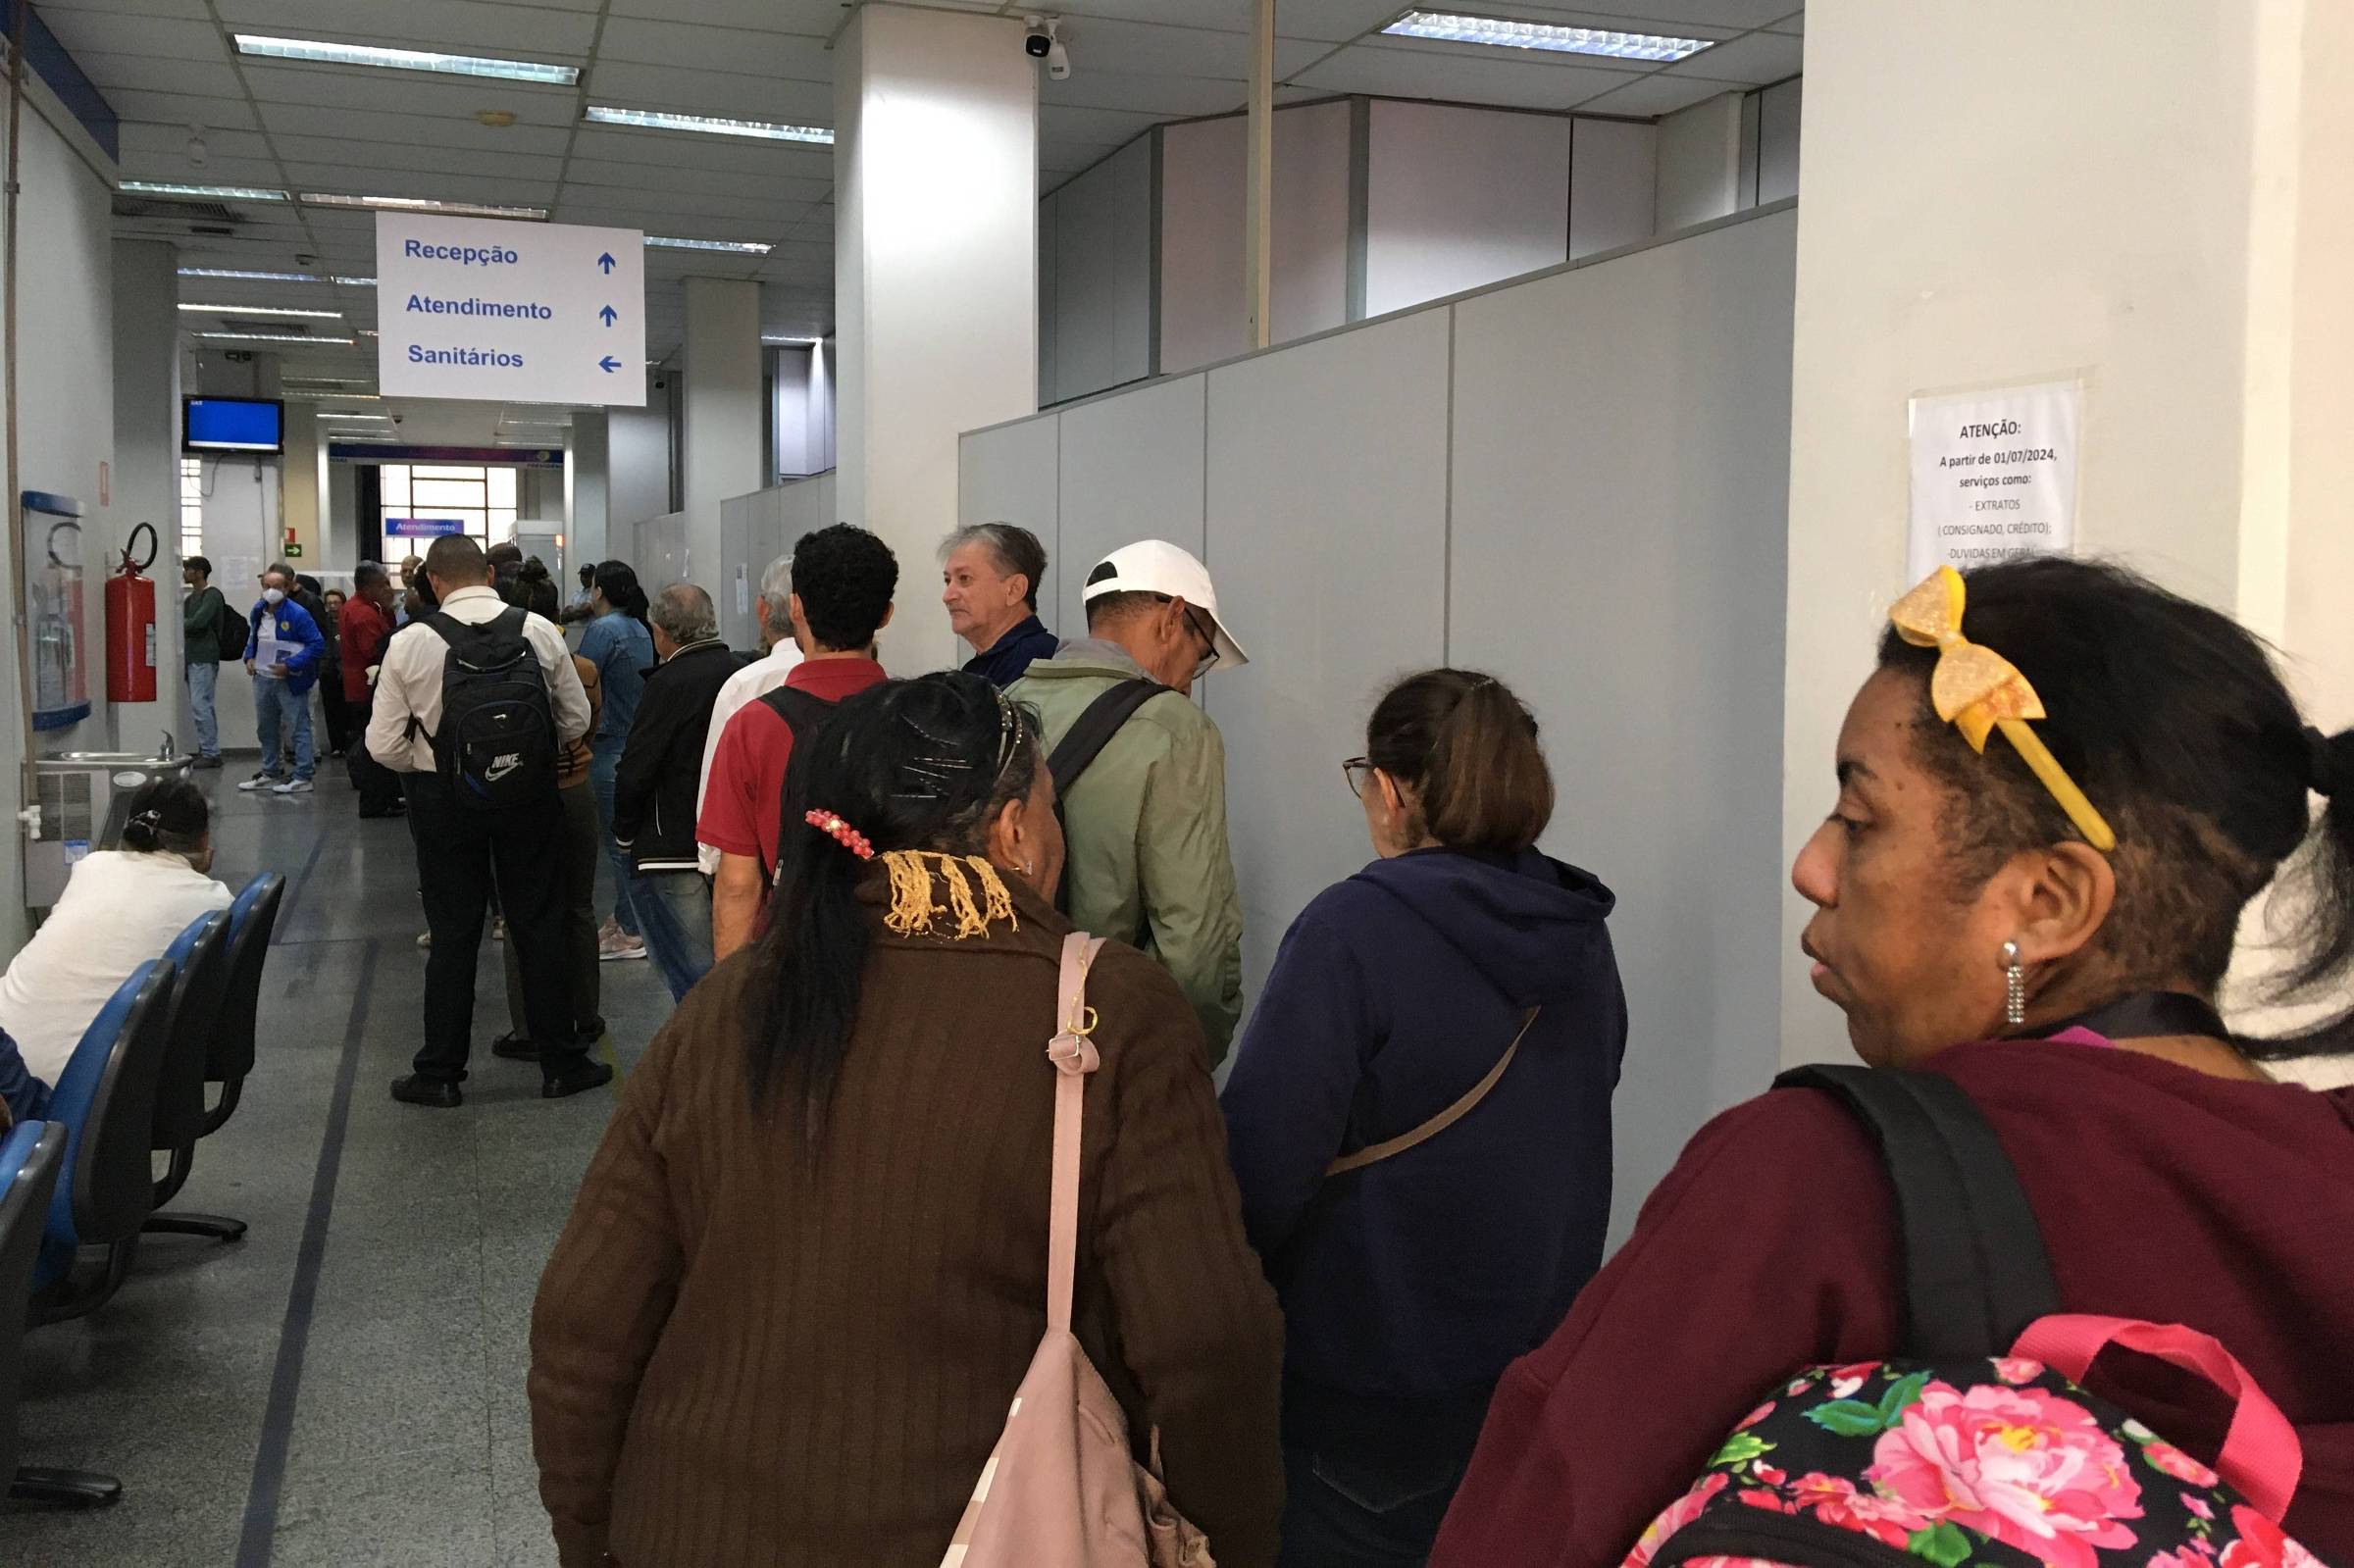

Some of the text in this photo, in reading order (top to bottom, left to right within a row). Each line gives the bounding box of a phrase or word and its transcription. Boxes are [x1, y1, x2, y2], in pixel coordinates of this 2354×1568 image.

[405, 239, 518, 266] Recepção
[406, 294, 552, 320] Atendimento
[408, 344, 524, 368] Sanitários
[1960, 419, 2021, 439] ATENÇÃO:
[1939, 448, 2058, 469] A partir de 01/07/2024,
[1959, 475, 2031, 489] serviços como:
[1974, 499, 2021, 511] EXTRATOS
[395, 523, 456, 531] Atendimento
[491, 753, 520, 769] NIKE
